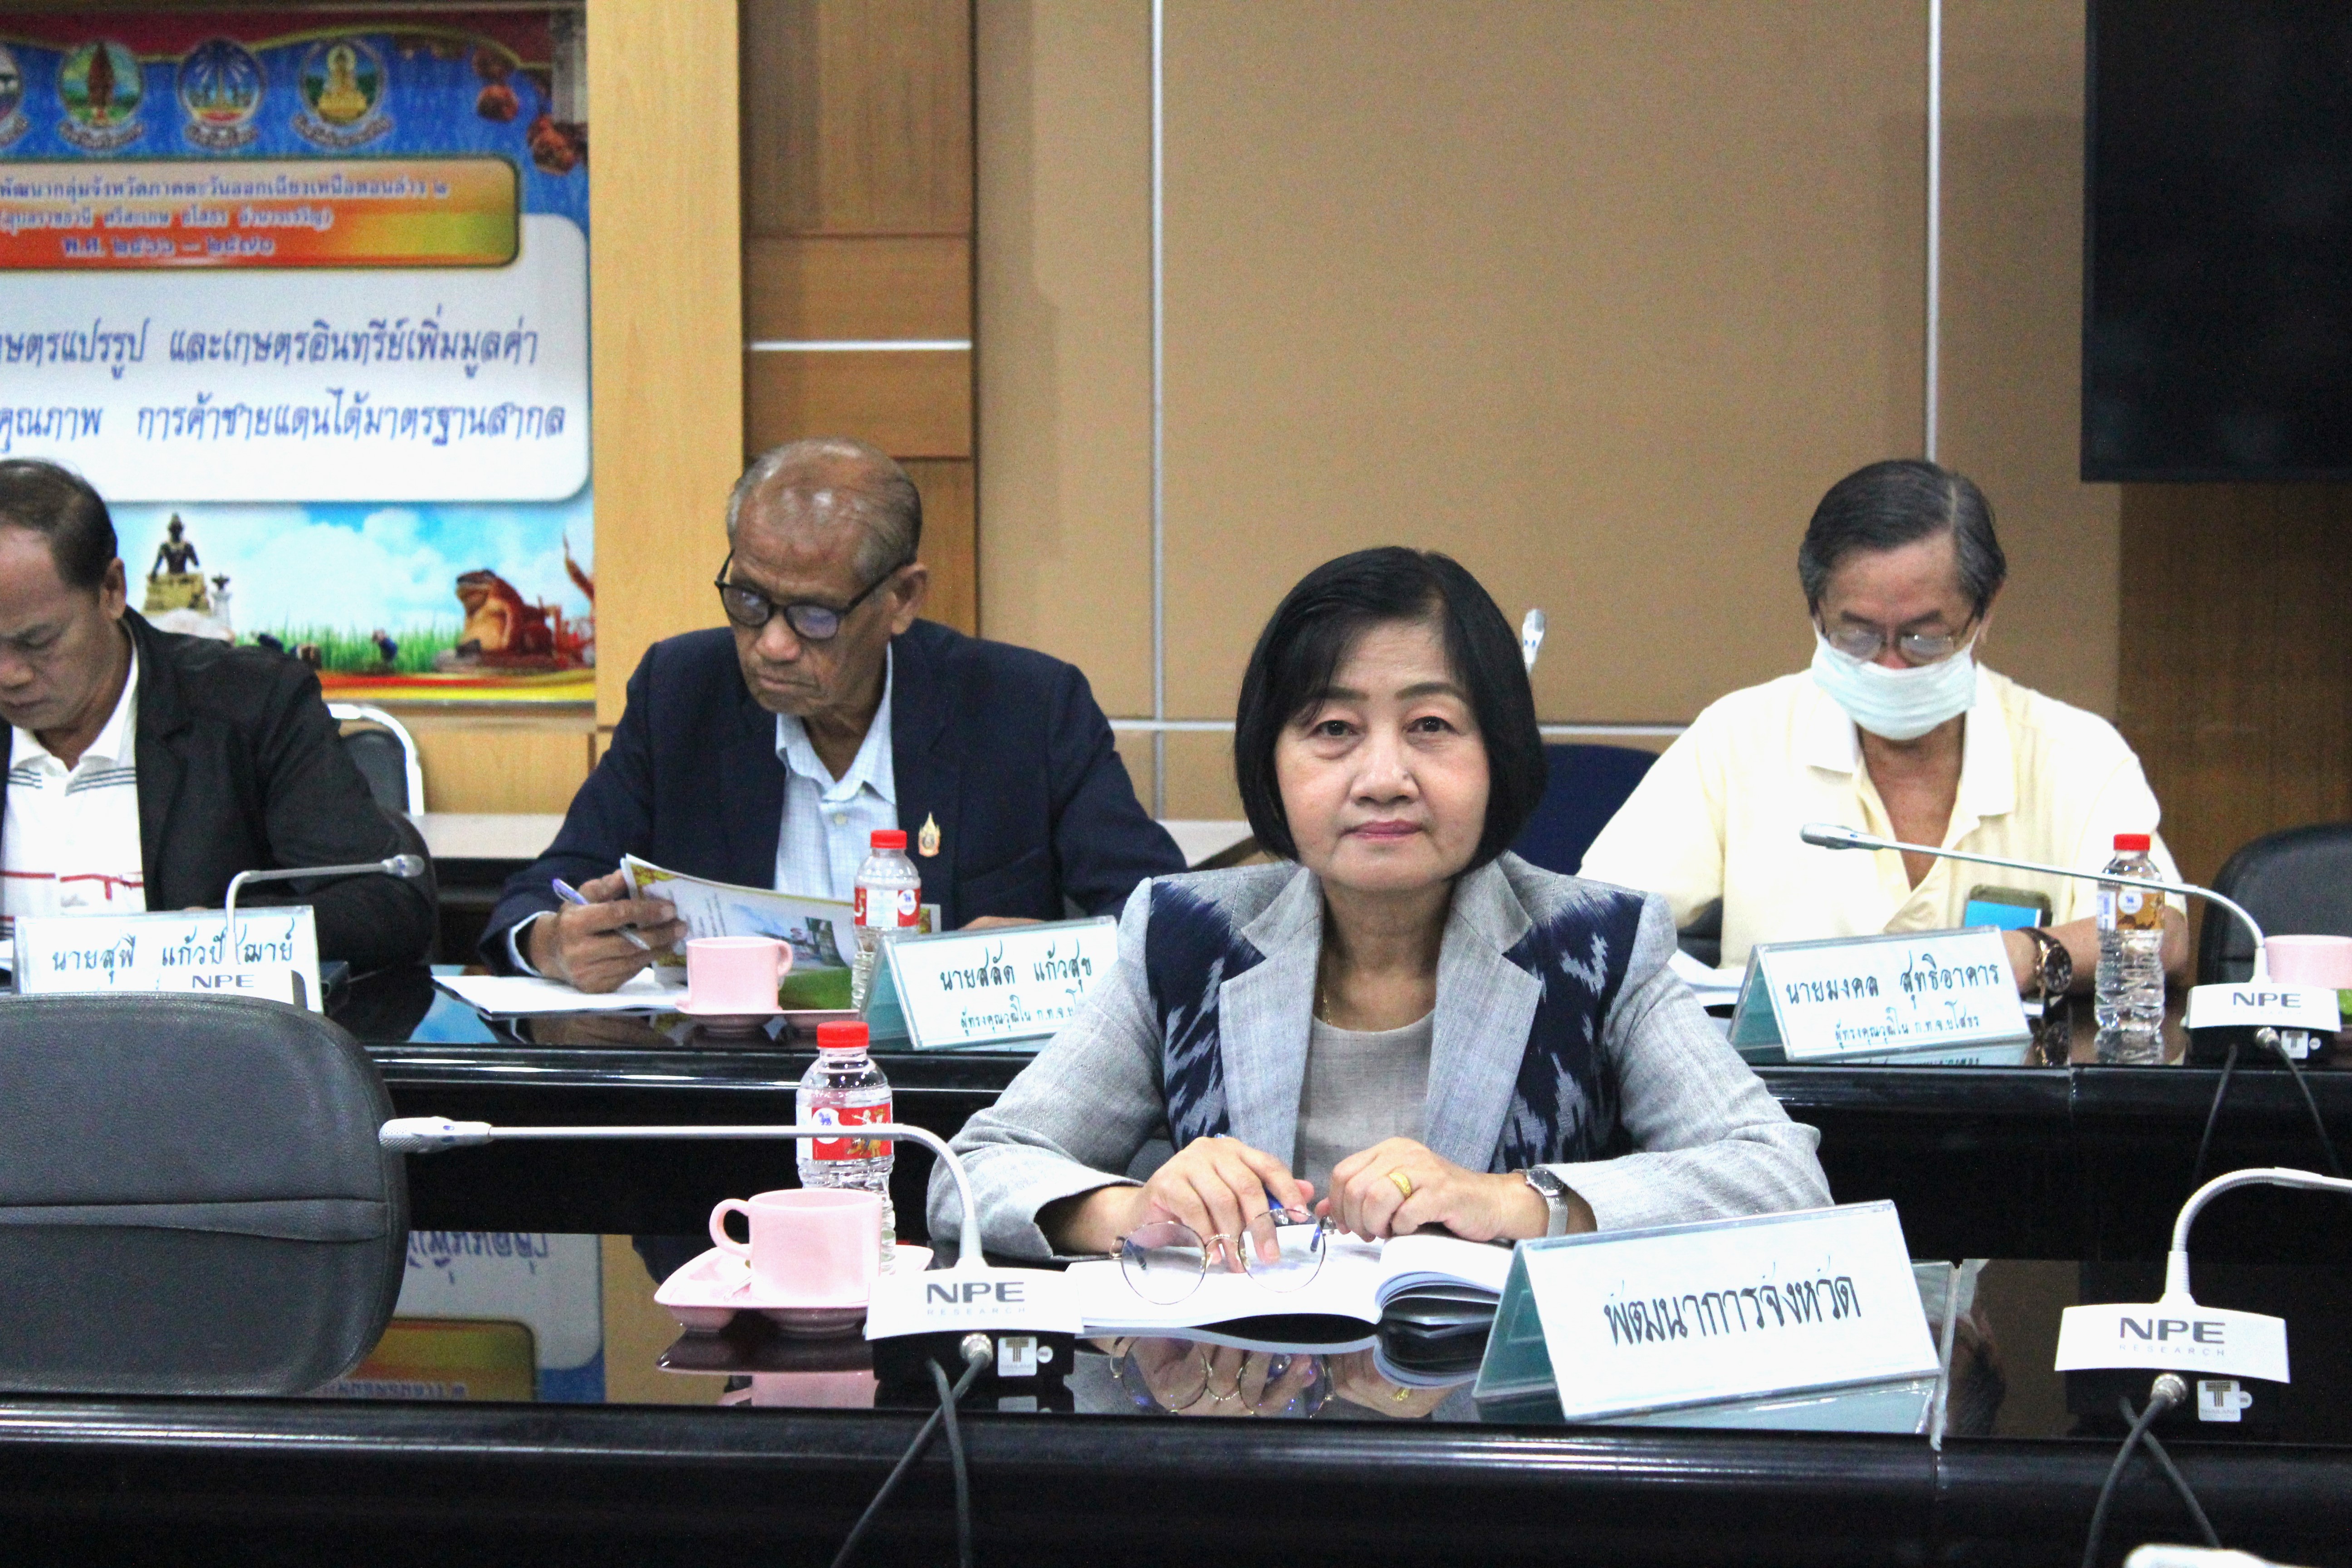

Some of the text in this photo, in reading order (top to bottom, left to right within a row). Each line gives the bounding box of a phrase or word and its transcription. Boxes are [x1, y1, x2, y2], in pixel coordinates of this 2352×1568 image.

[0, 303, 539, 380] ษตรแปรรูป และเกษตรอินทรีย์เพิ่มมูลค่า
[138, 387, 566, 446] การค้าชายแดนได้มาตรฐานสากล
[192, 975, 255, 989] NPE
[1786, 975, 1879, 1004] นายมงคล
[2233, 992, 2302, 1008] NPE
[926, 1281, 1025, 1304] NPE
[1603, 1254, 1861, 1346] พัฒนาการจังหวัด
[927, 1307, 1025, 1316] RESEARCH
[2120, 1317, 2226, 1344] NPE
[2119, 1344, 2225, 1356] RESEARCH
